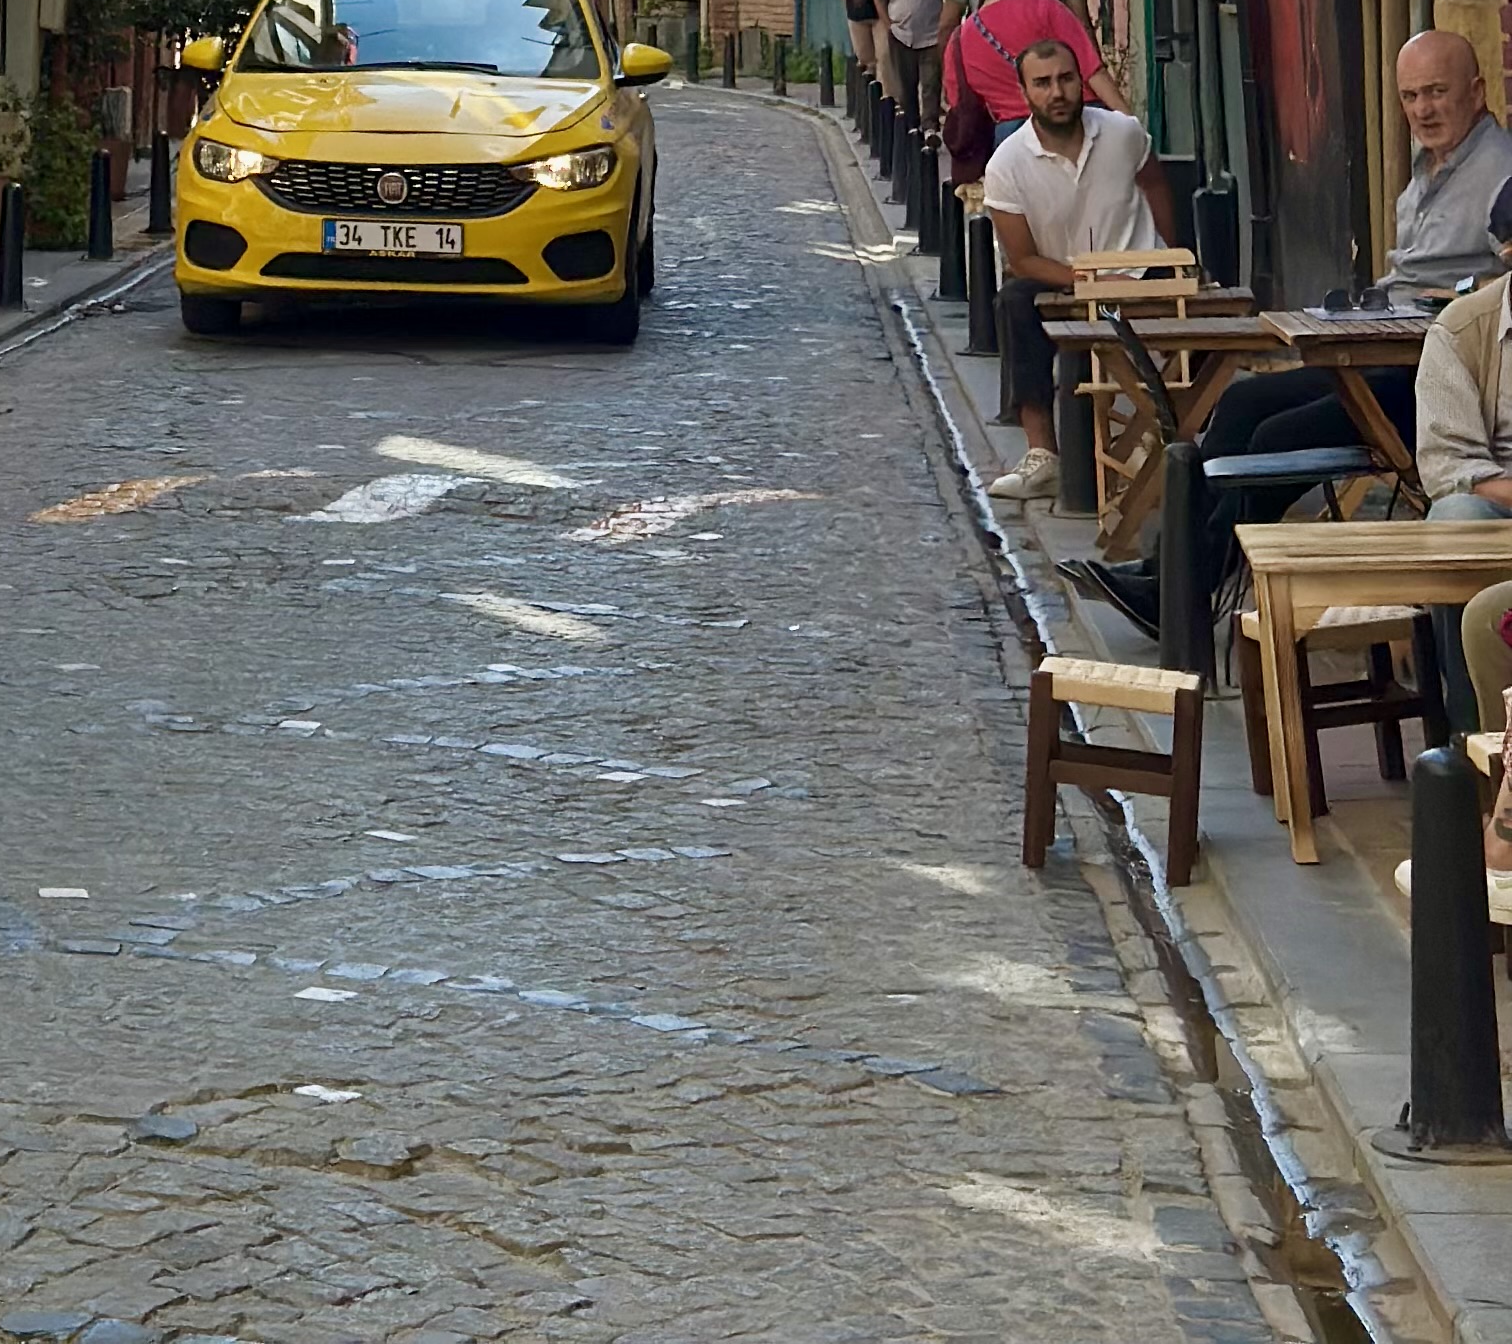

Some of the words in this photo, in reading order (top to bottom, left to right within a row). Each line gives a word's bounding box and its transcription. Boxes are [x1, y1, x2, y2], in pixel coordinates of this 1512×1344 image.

[339, 224, 363, 246] 34
[380, 225, 417, 248] TKE
[435, 227, 456, 250] 14
